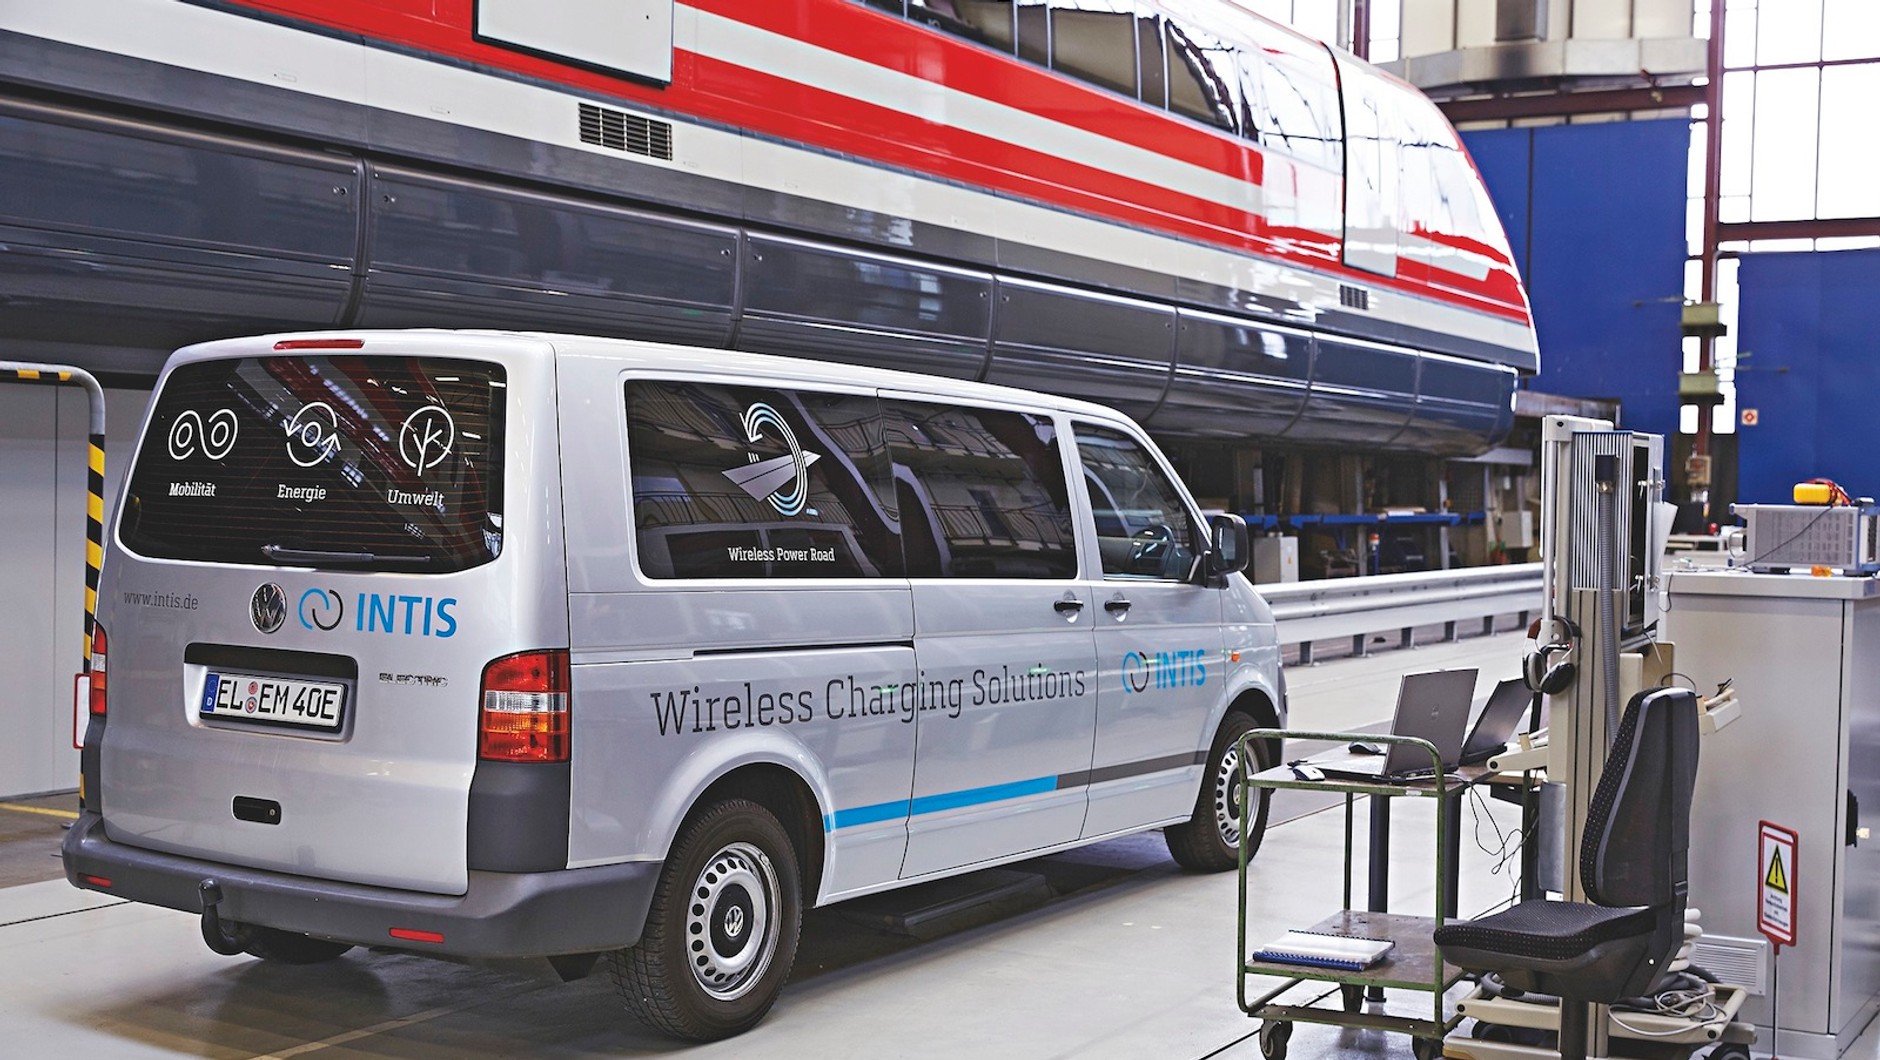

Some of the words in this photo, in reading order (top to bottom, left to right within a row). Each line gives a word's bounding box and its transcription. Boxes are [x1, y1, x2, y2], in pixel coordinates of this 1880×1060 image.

[168, 482, 217, 497] Mobilität
[277, 484, 327, 503] Energie
[387, 488, 445, 507] Umwelt
[728, 546, 775, 561] Wireless
[776, 547, 808, 561] Power
[810, 547, 835, 561] Road
[124, 590, 199, 610] www.intis.de
[356, 592, 458, 638] INTIS
[1155, 648, 1206, 689] INTIS
[216, 679, 243, 710] EL
[258, 683, 290, 715] EM
[292, 686, 338, 720] 40E
[650, 682, 813, 736] Wireless
[826, 675, 964, 723] Charging
[972, 662, 1085, 706] Solutions
